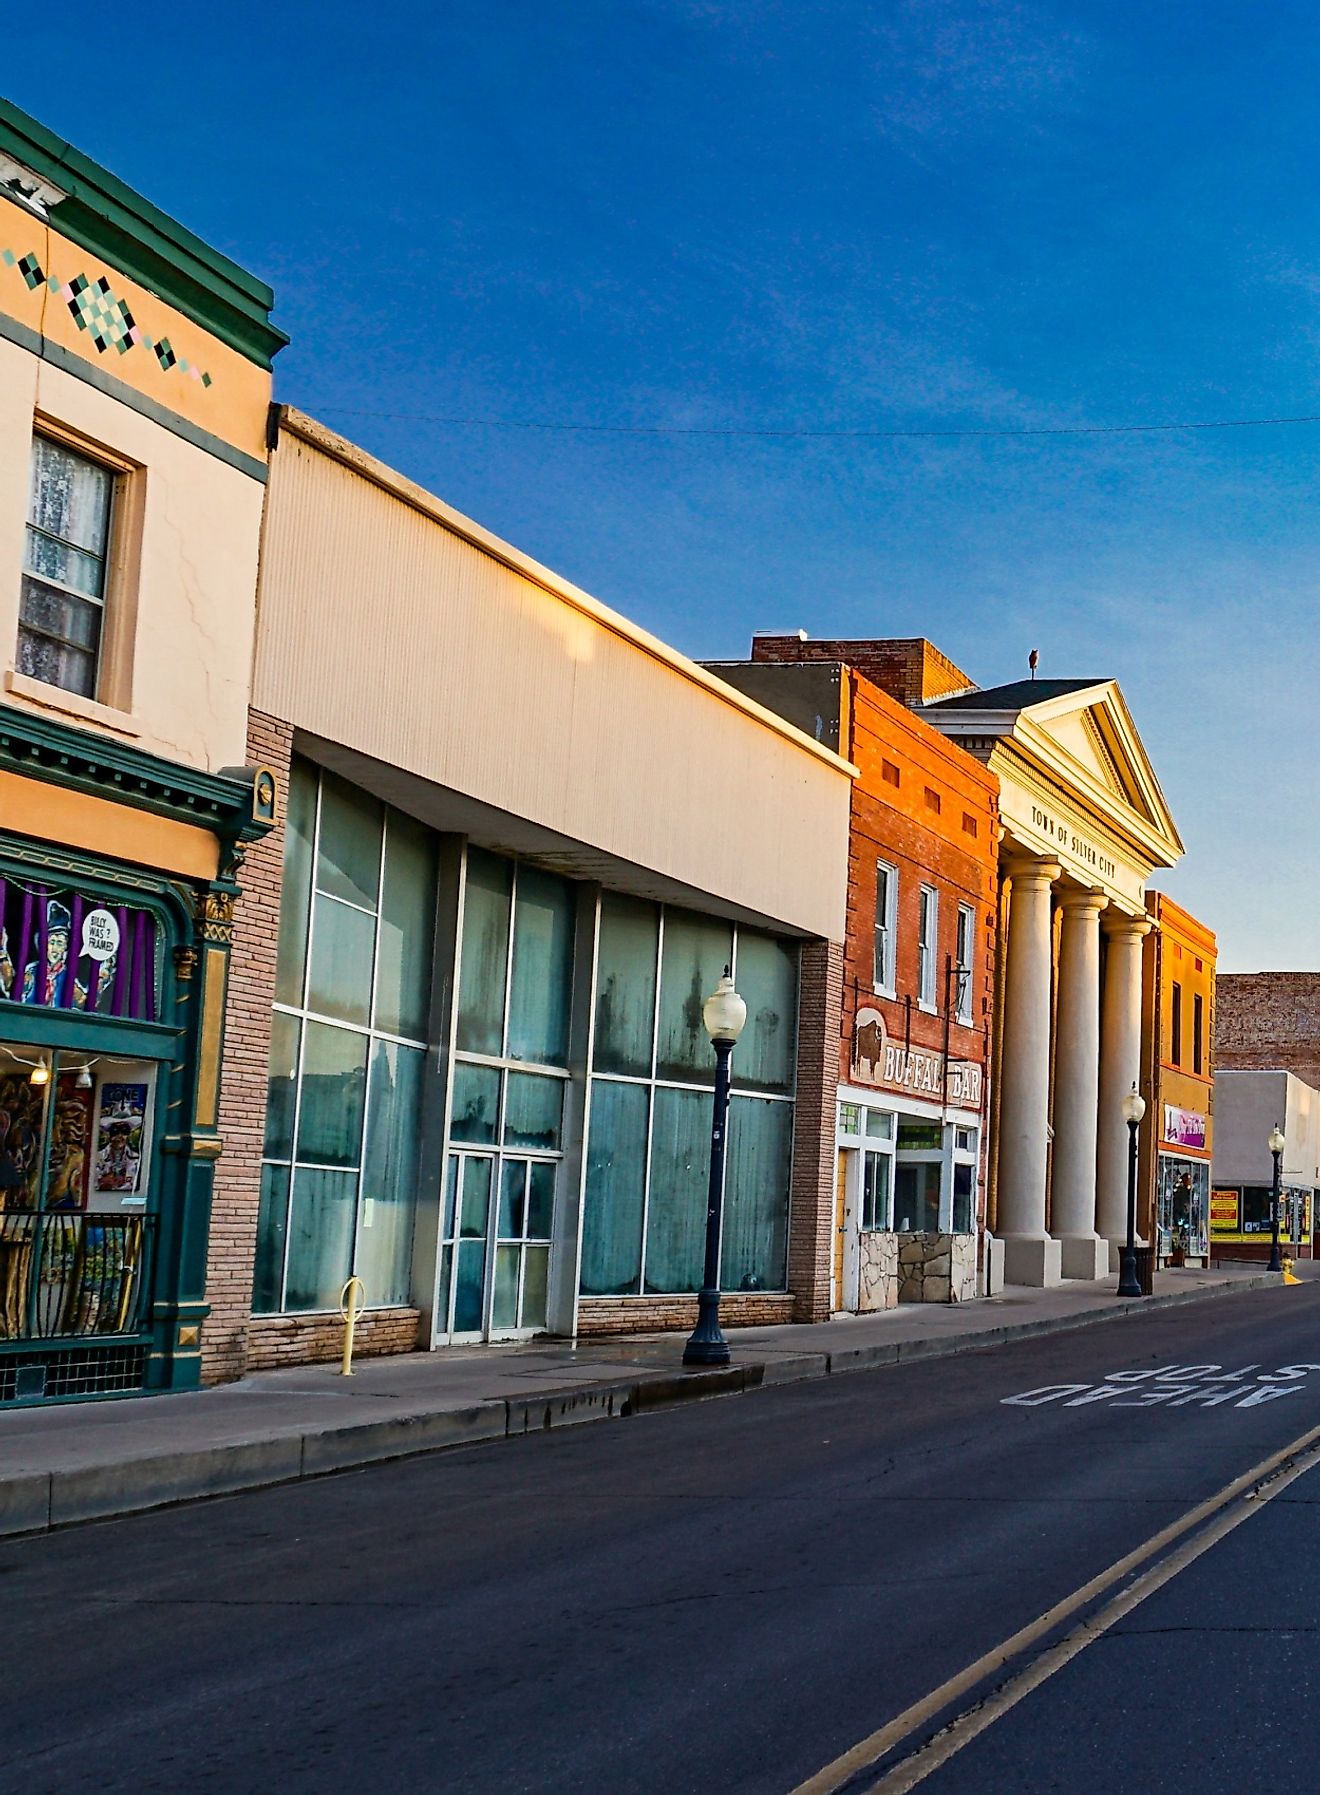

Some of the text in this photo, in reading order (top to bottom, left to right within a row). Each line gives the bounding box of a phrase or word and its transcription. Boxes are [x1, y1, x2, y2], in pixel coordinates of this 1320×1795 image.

[1032, 806, 1115, 879] TOWN OF SILVER CITY
[89, 927, 104, 939] WAS
[883, 1045, 980, 1102] BUFFAL BAR
[1000, 1384, 1306, 1408] AHEAD
